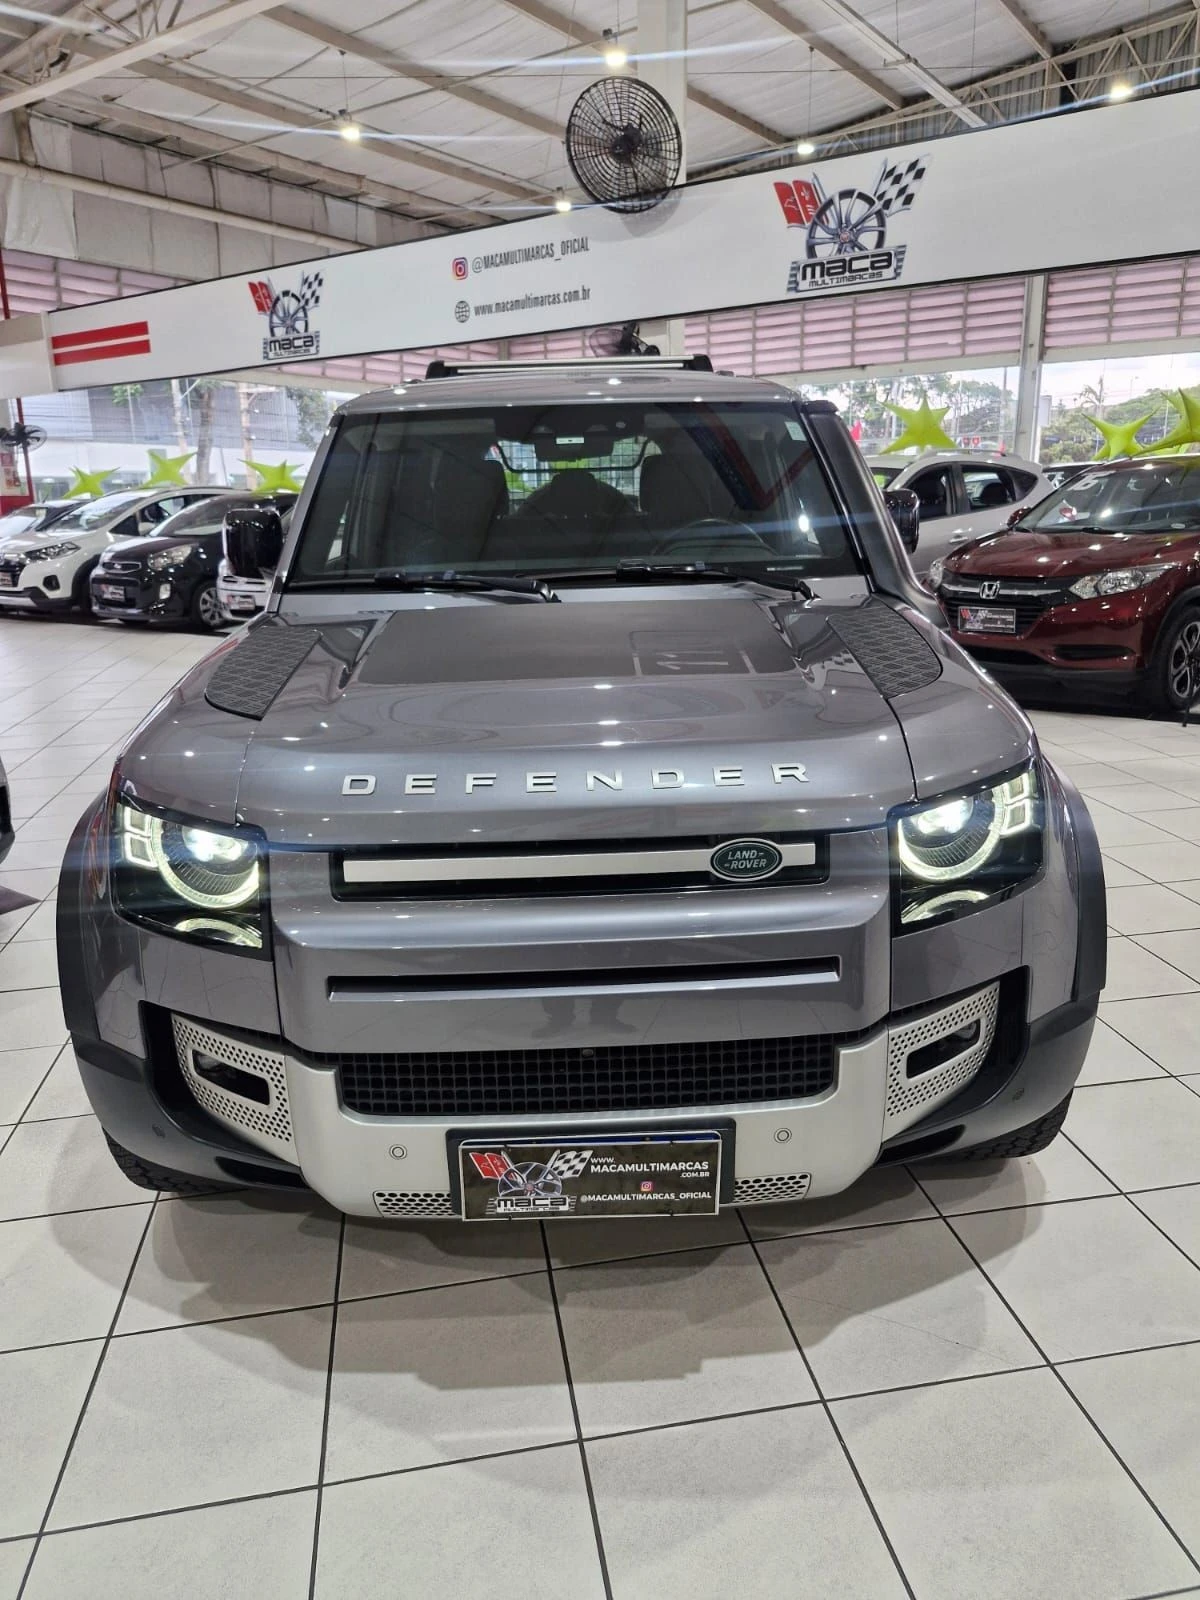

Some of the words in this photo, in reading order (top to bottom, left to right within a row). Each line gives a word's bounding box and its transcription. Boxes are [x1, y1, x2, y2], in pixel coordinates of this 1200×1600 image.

[472, 237, 589, 273] @MACAMULTIMARCAS_OFICIAL
[474, 285, 590, 316] www.macamultimarcas.com.br
[341, 763, 809, 795] DEFENDER
[590, 1161, 709, 1173] MACAMULTIMARCAS
[580, 1191, 712, 1203] @MACAMULTIMARCAS_OFICIAL
